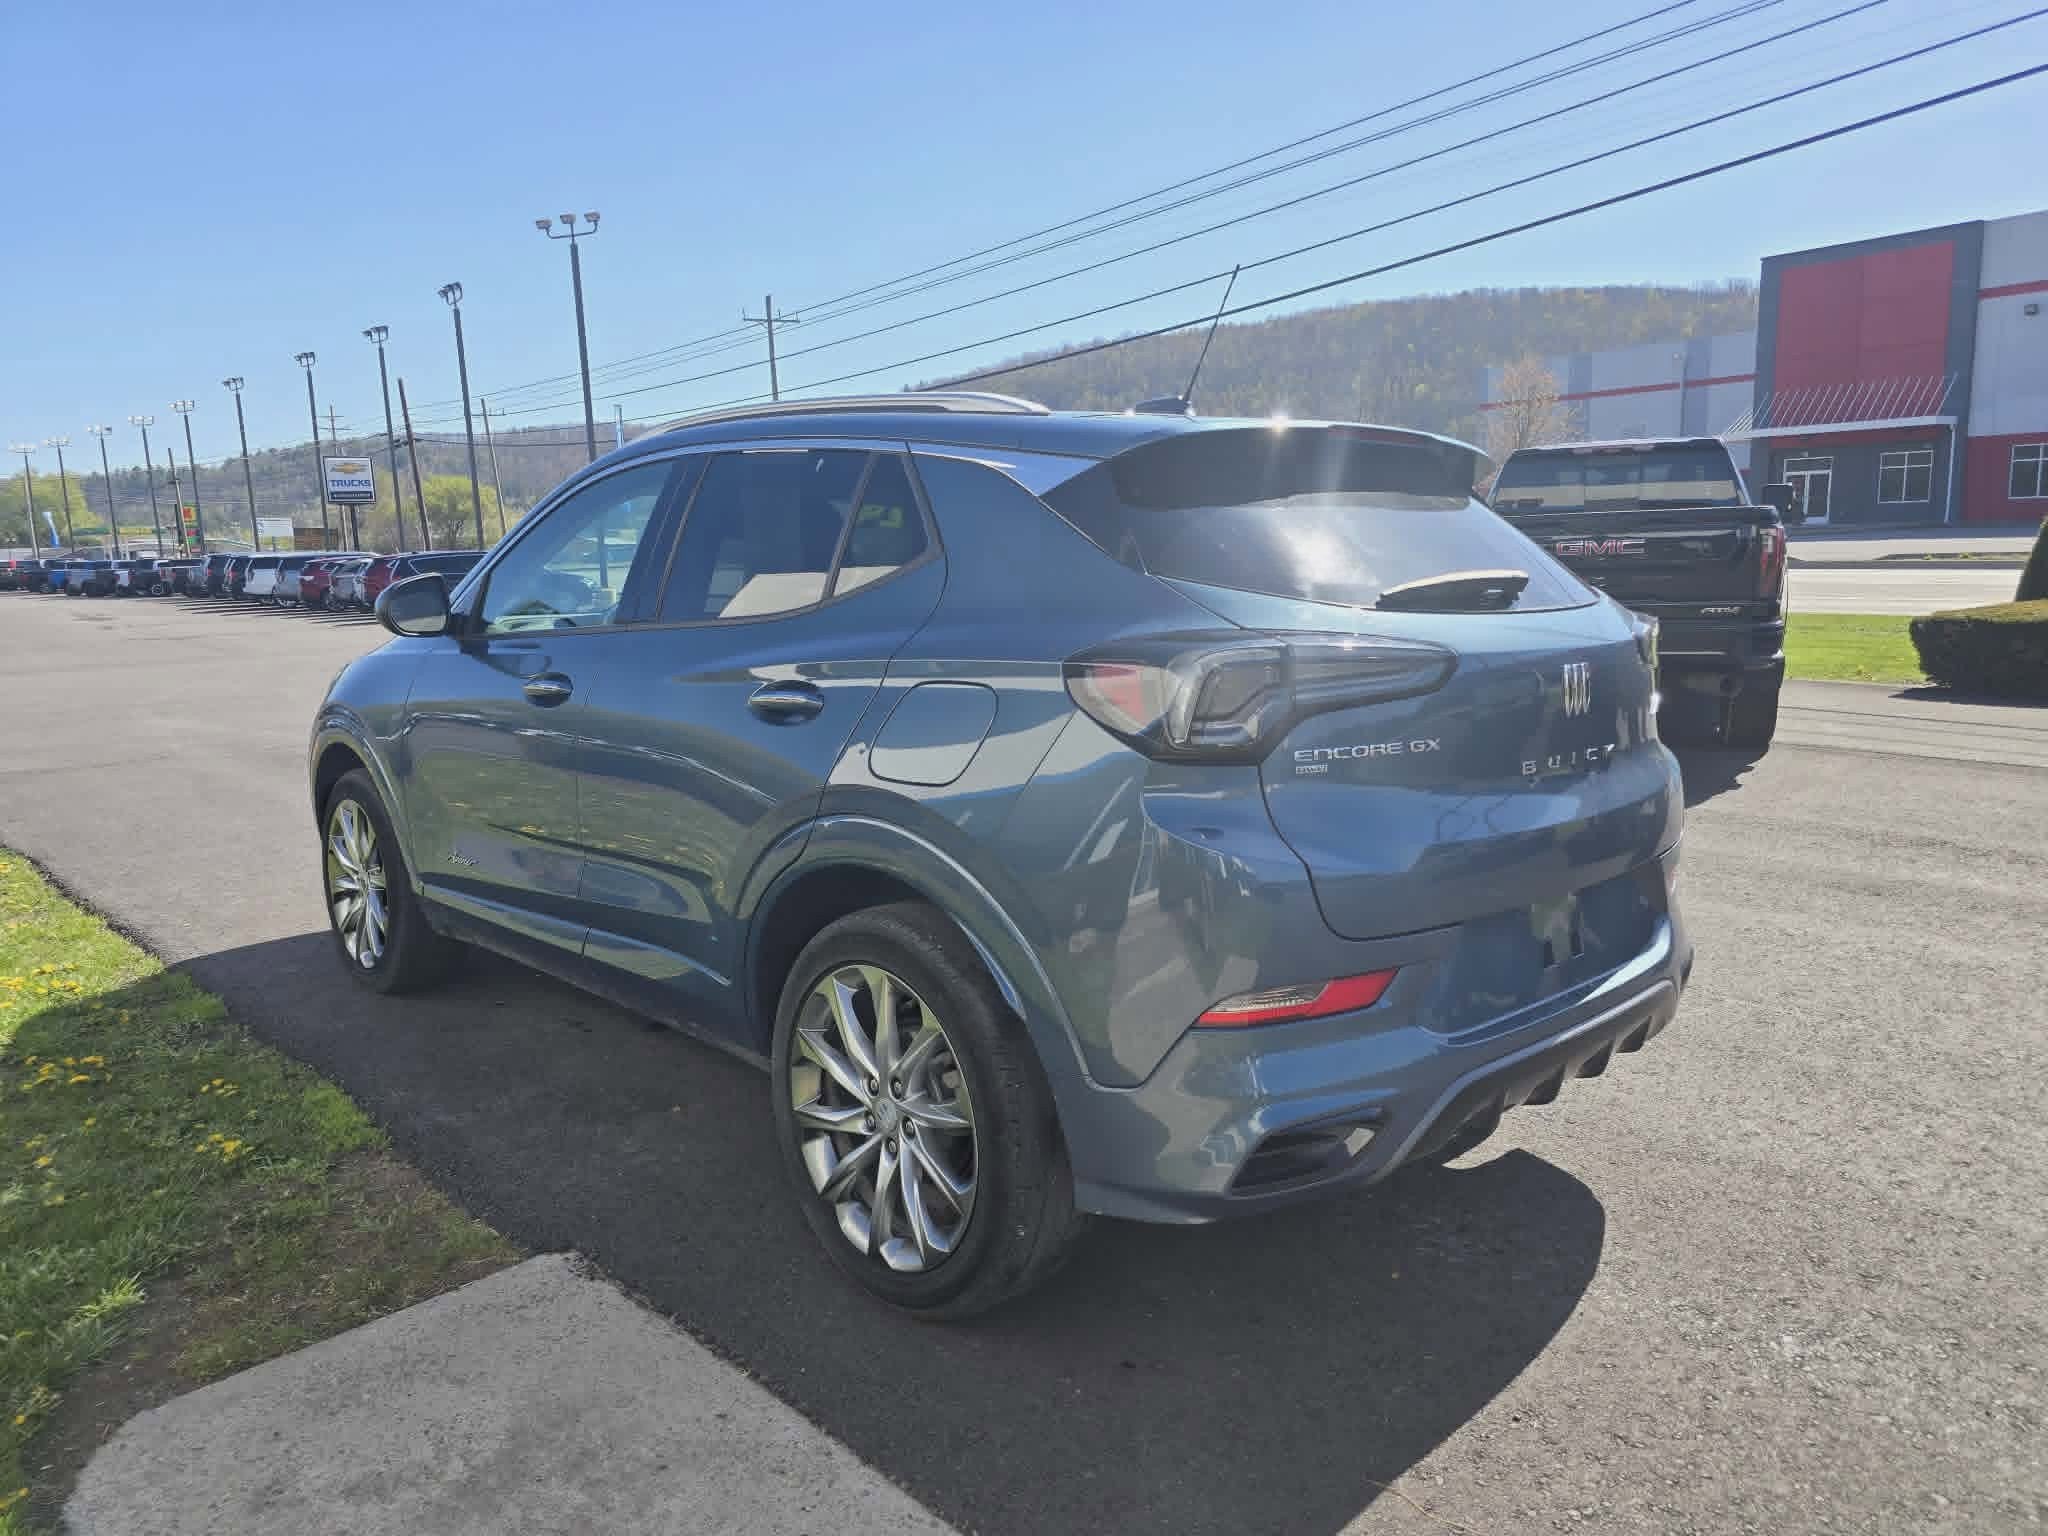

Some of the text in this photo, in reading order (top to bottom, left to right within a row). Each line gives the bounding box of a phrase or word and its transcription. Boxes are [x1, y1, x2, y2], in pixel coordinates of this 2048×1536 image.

[330, 479, 371, 488] TRUCKS
[1556, 538, 1646, 556] GMC
[1294, 737, 1441, 762] ENCORE GX
